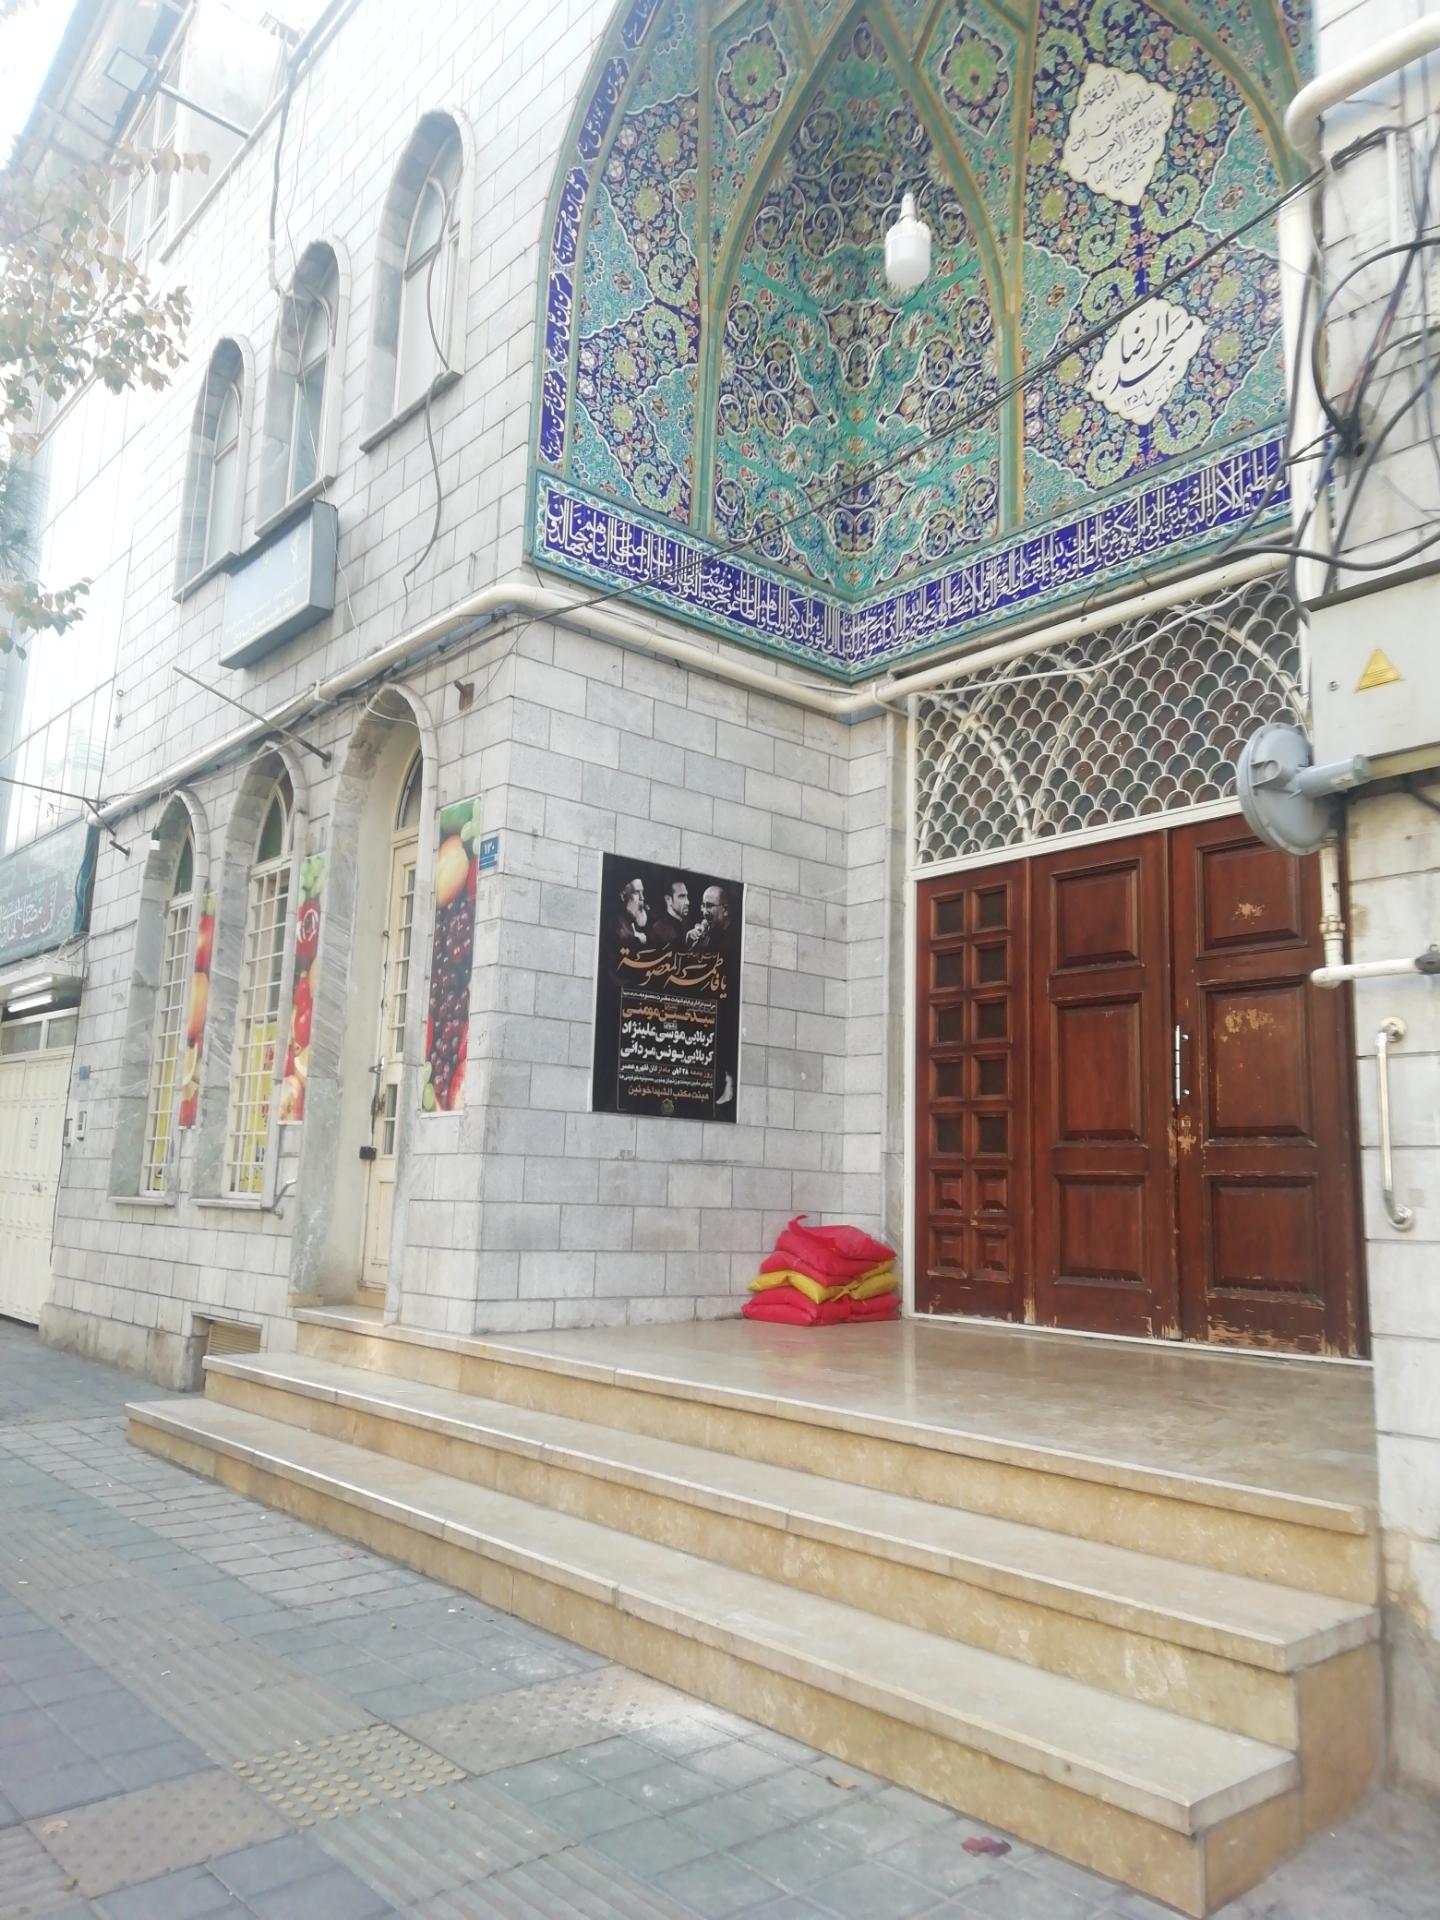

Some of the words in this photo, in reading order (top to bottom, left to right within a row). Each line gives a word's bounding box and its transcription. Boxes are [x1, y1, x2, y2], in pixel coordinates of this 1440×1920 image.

[655, 1029, 686, 1043] موسی
[685, 1030, 715, 1047] کربلایی
[620, 1041, 656, 1059] مردانی
[656, 1045, 685, 1062] یونس
[684, 1049, 714, 1066] کربلایی
